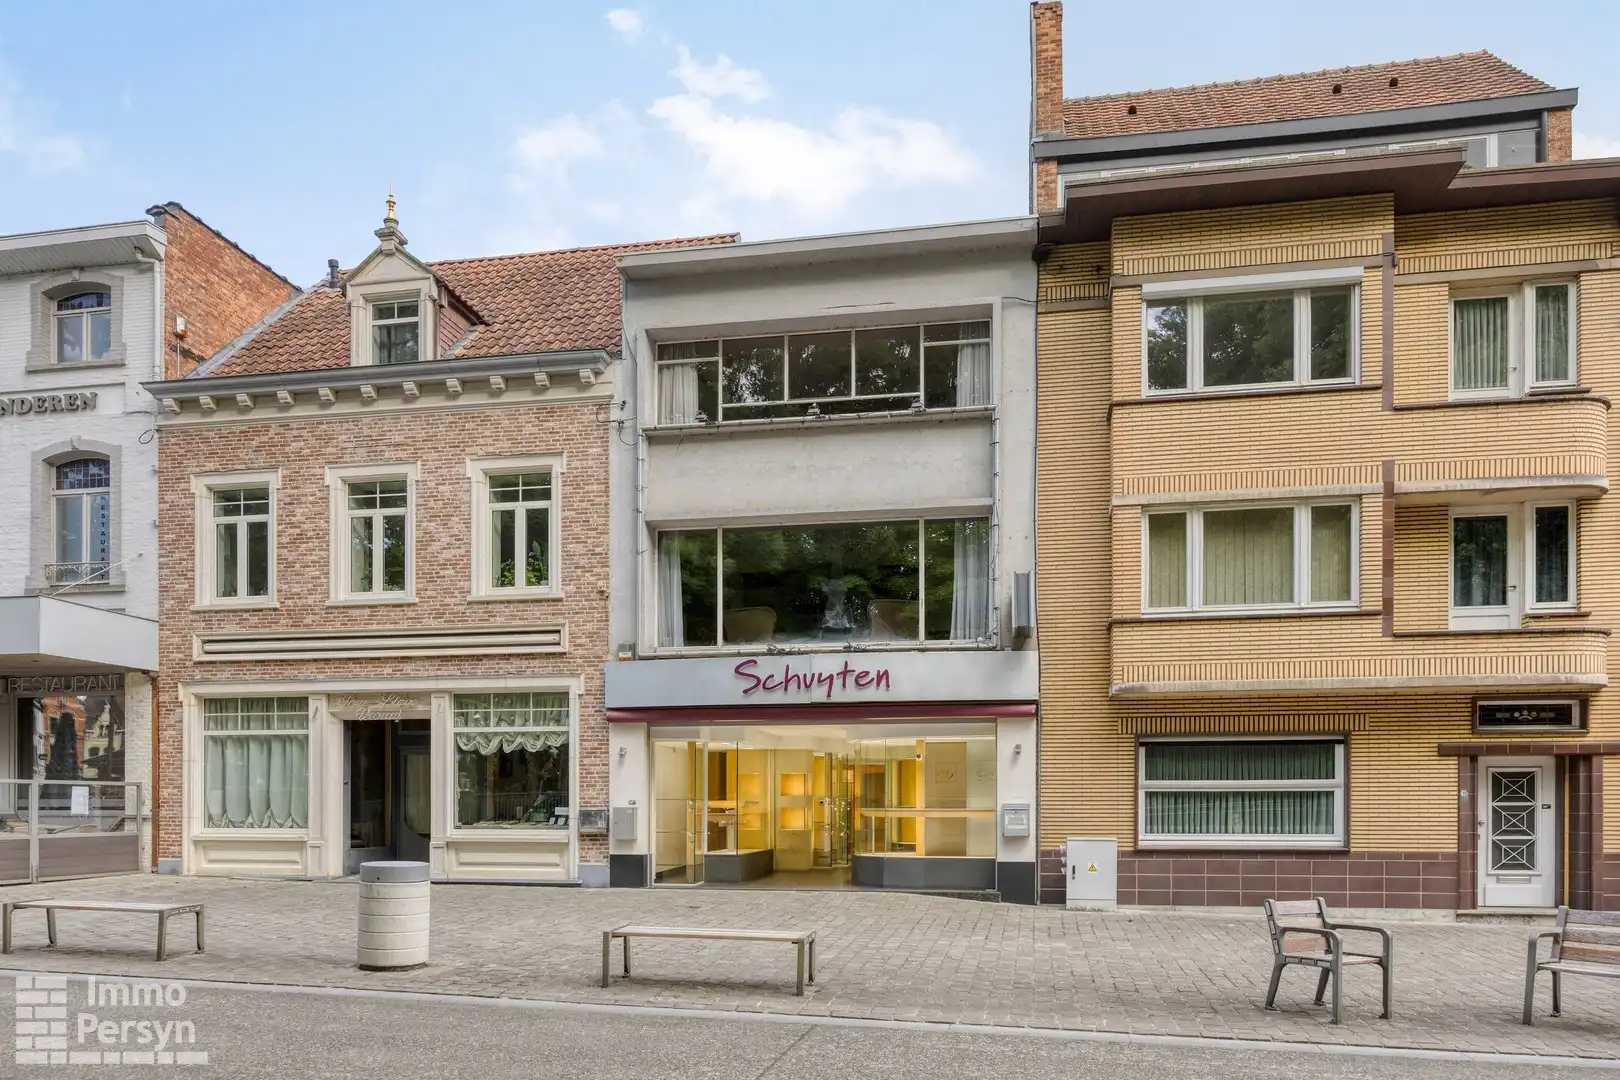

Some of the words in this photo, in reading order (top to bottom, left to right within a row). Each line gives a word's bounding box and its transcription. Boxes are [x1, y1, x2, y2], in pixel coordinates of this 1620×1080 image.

[0, 391, 98, 416] NDEREN
[7, 674, 120, 694] RESTAURANT
[734, 659, 891, 697] Schuyten
